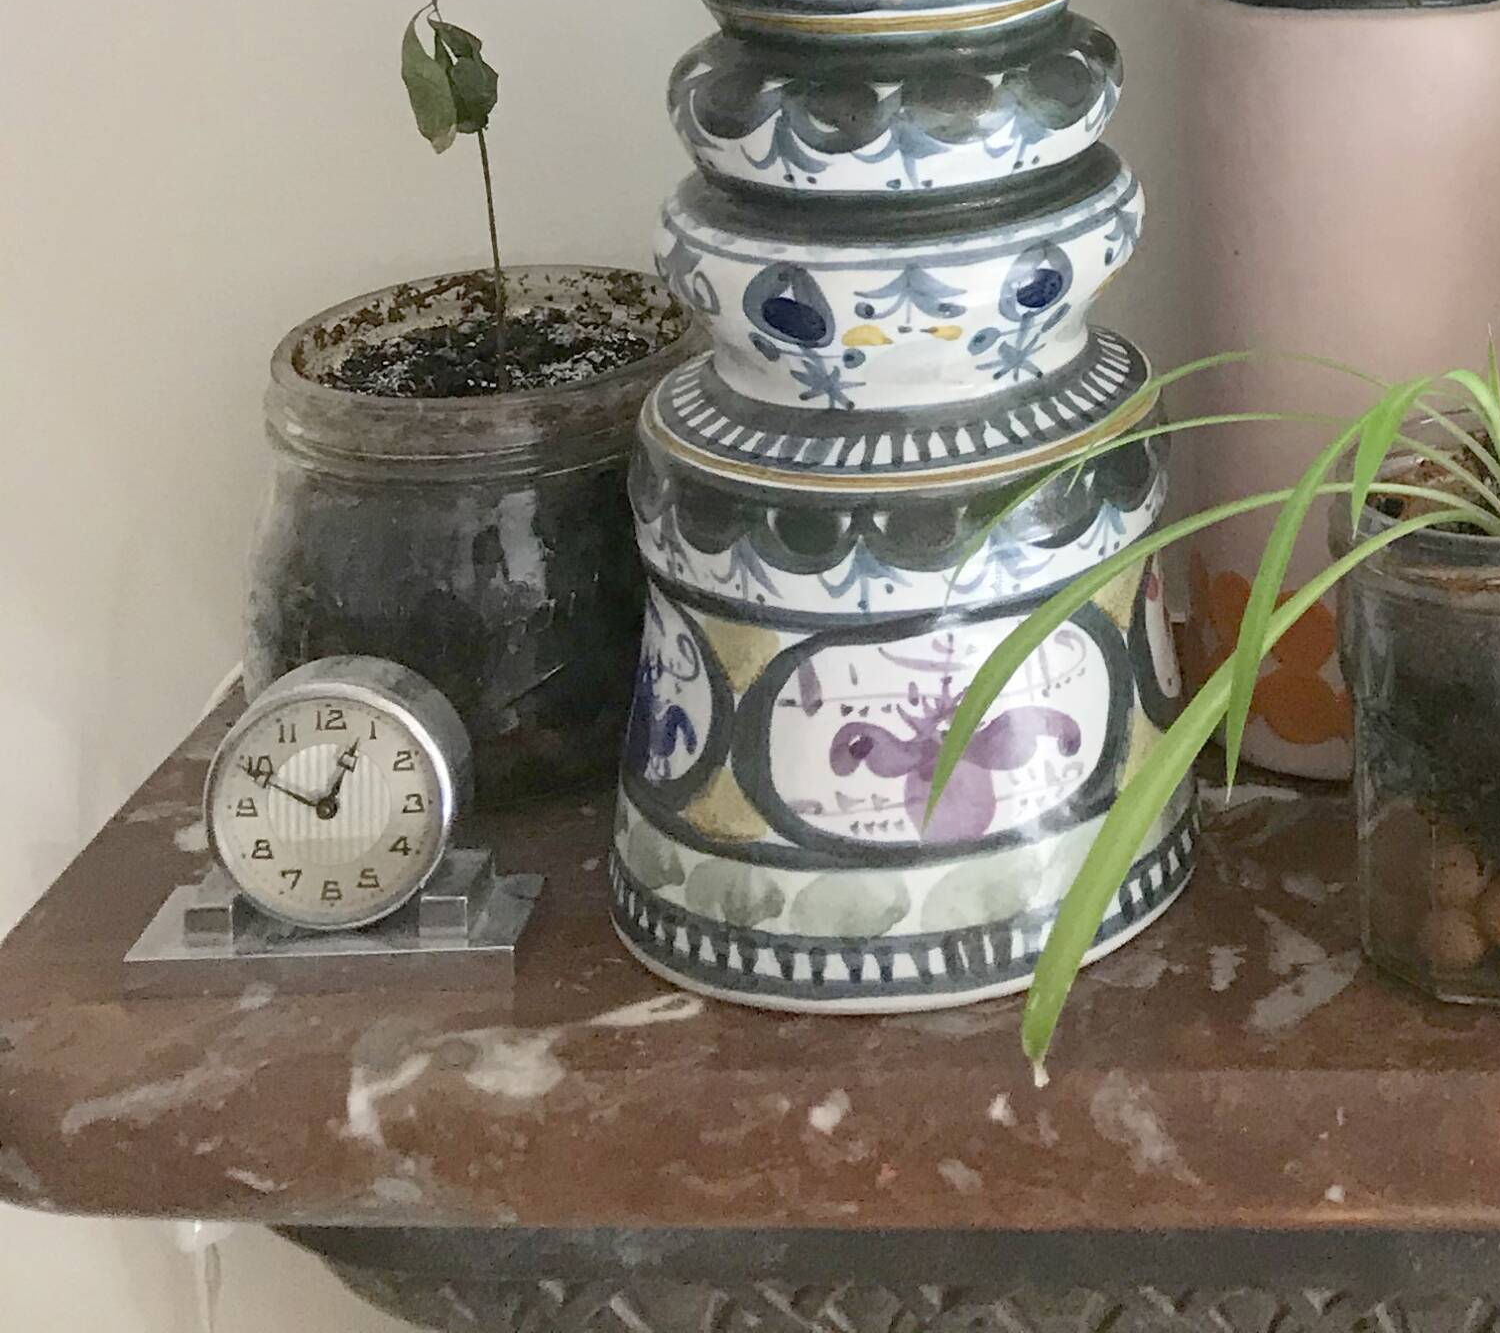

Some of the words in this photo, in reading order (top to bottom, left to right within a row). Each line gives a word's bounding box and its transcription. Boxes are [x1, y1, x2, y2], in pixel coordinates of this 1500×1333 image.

[315, 709, 347, 731] 12
[368, 720, 377, 740] 1
[278, 723, 297, 744] 11
[392, 750, 415, 772] 2
[235, 797, 259, 818] 9
[402, 792, 425, 814] 3
[251, 838, 275, 860] 8
[388, 835, 412, 856] 4
[280, 868, 302, 890] 7
[356, 867, 381, 889] 5
[320, 880, 343, 901] 6
